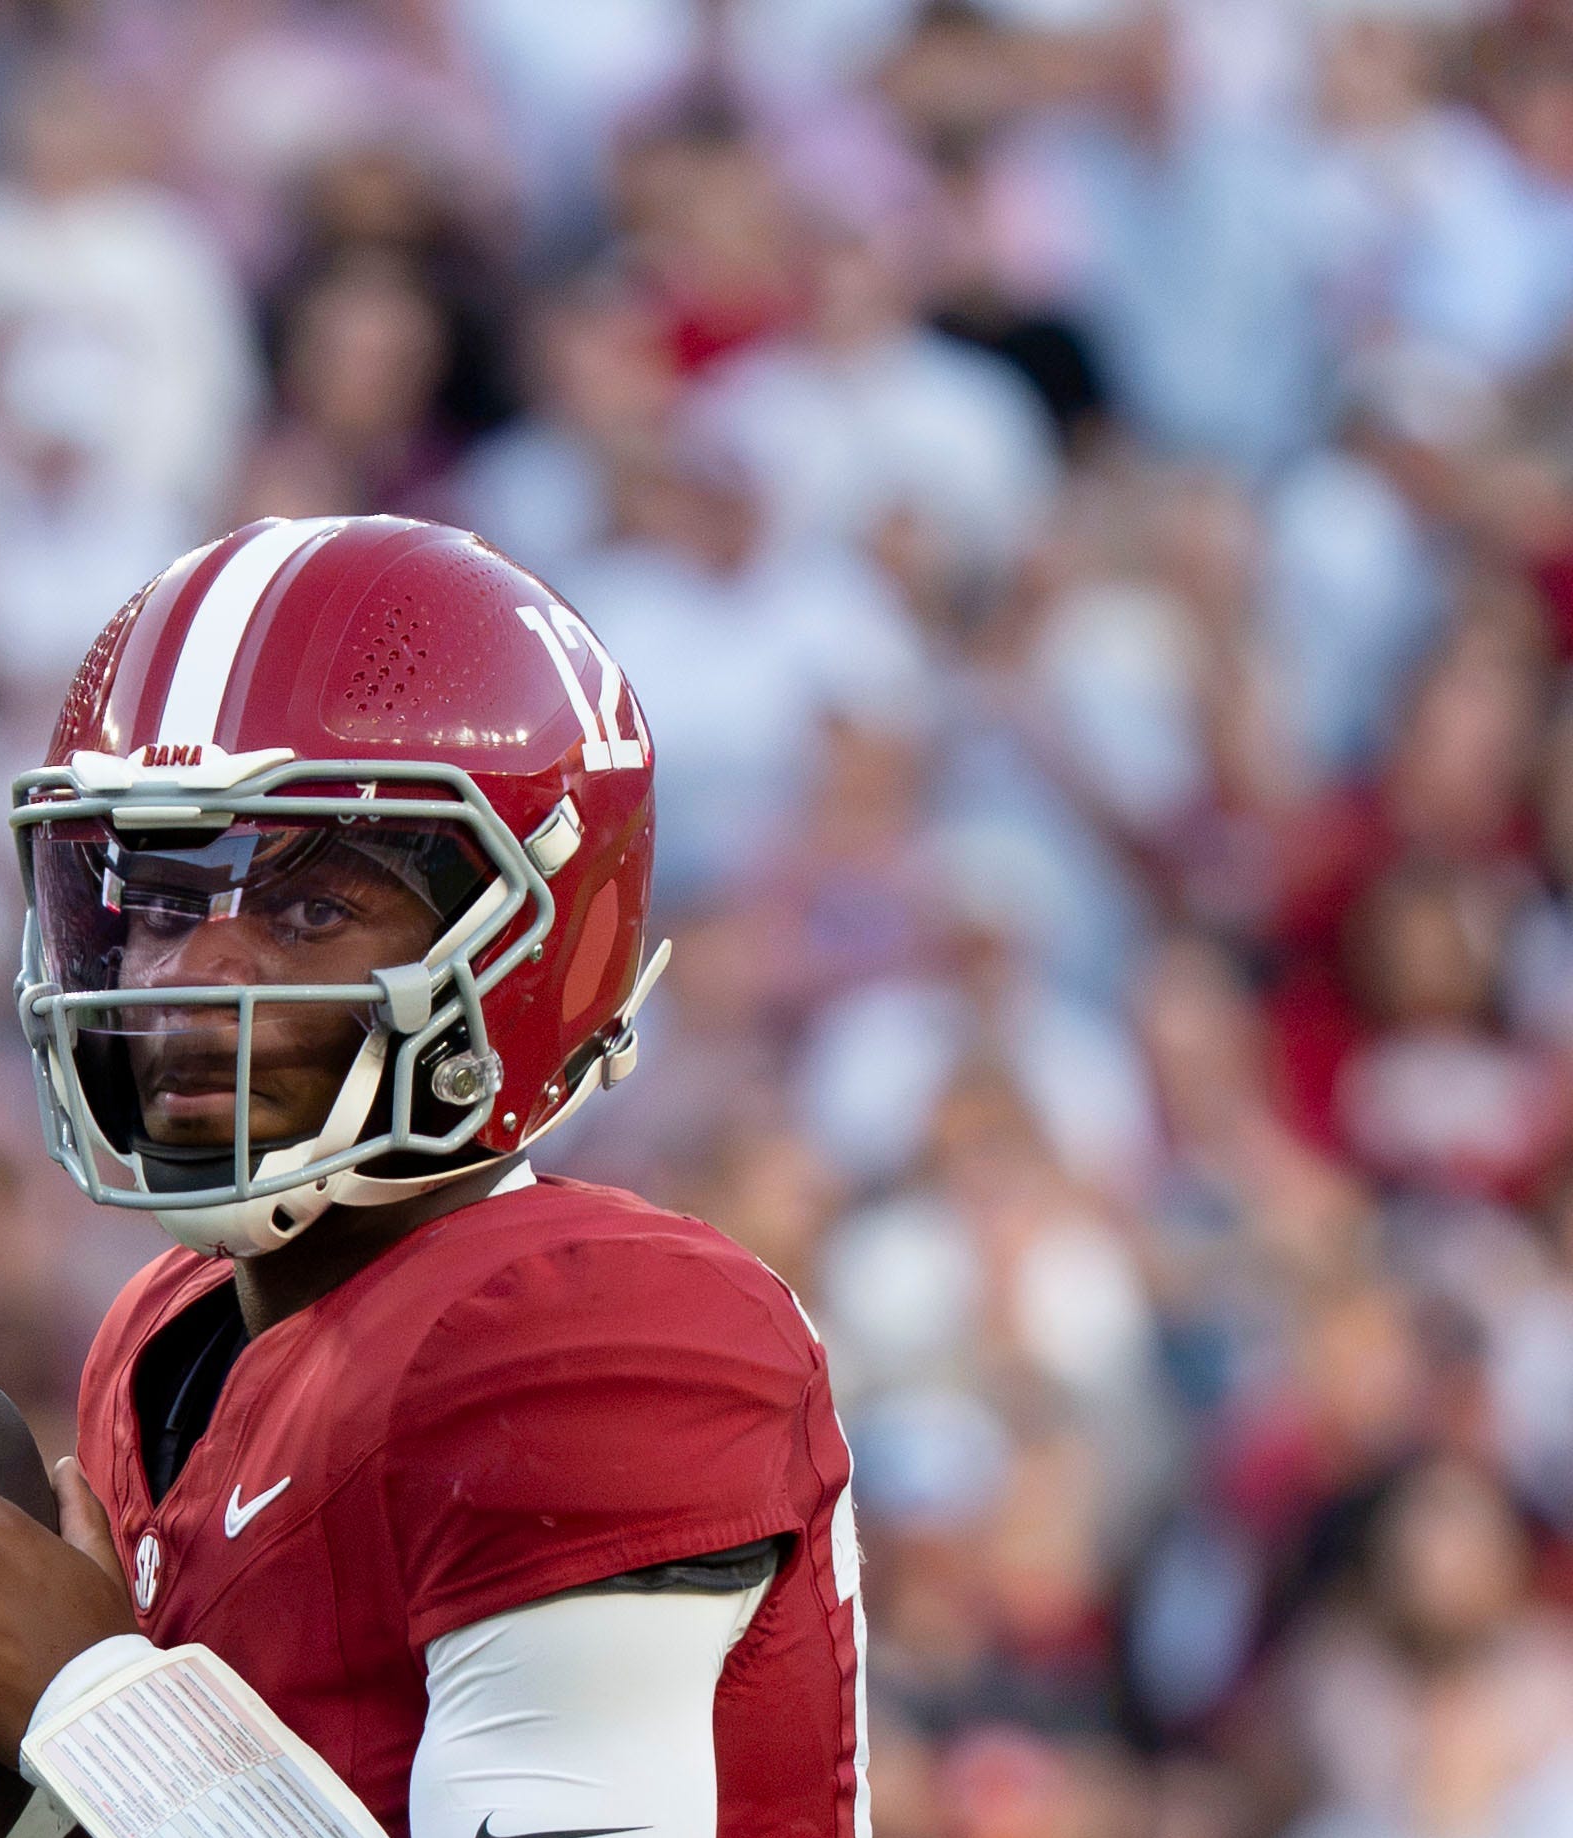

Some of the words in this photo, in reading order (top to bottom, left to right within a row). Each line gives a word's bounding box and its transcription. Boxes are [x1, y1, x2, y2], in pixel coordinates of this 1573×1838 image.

[515, 604, 652, 772] 12
[142, 744, 202, 767] BAMA
[135, 1535, 160, 1610] SEC
